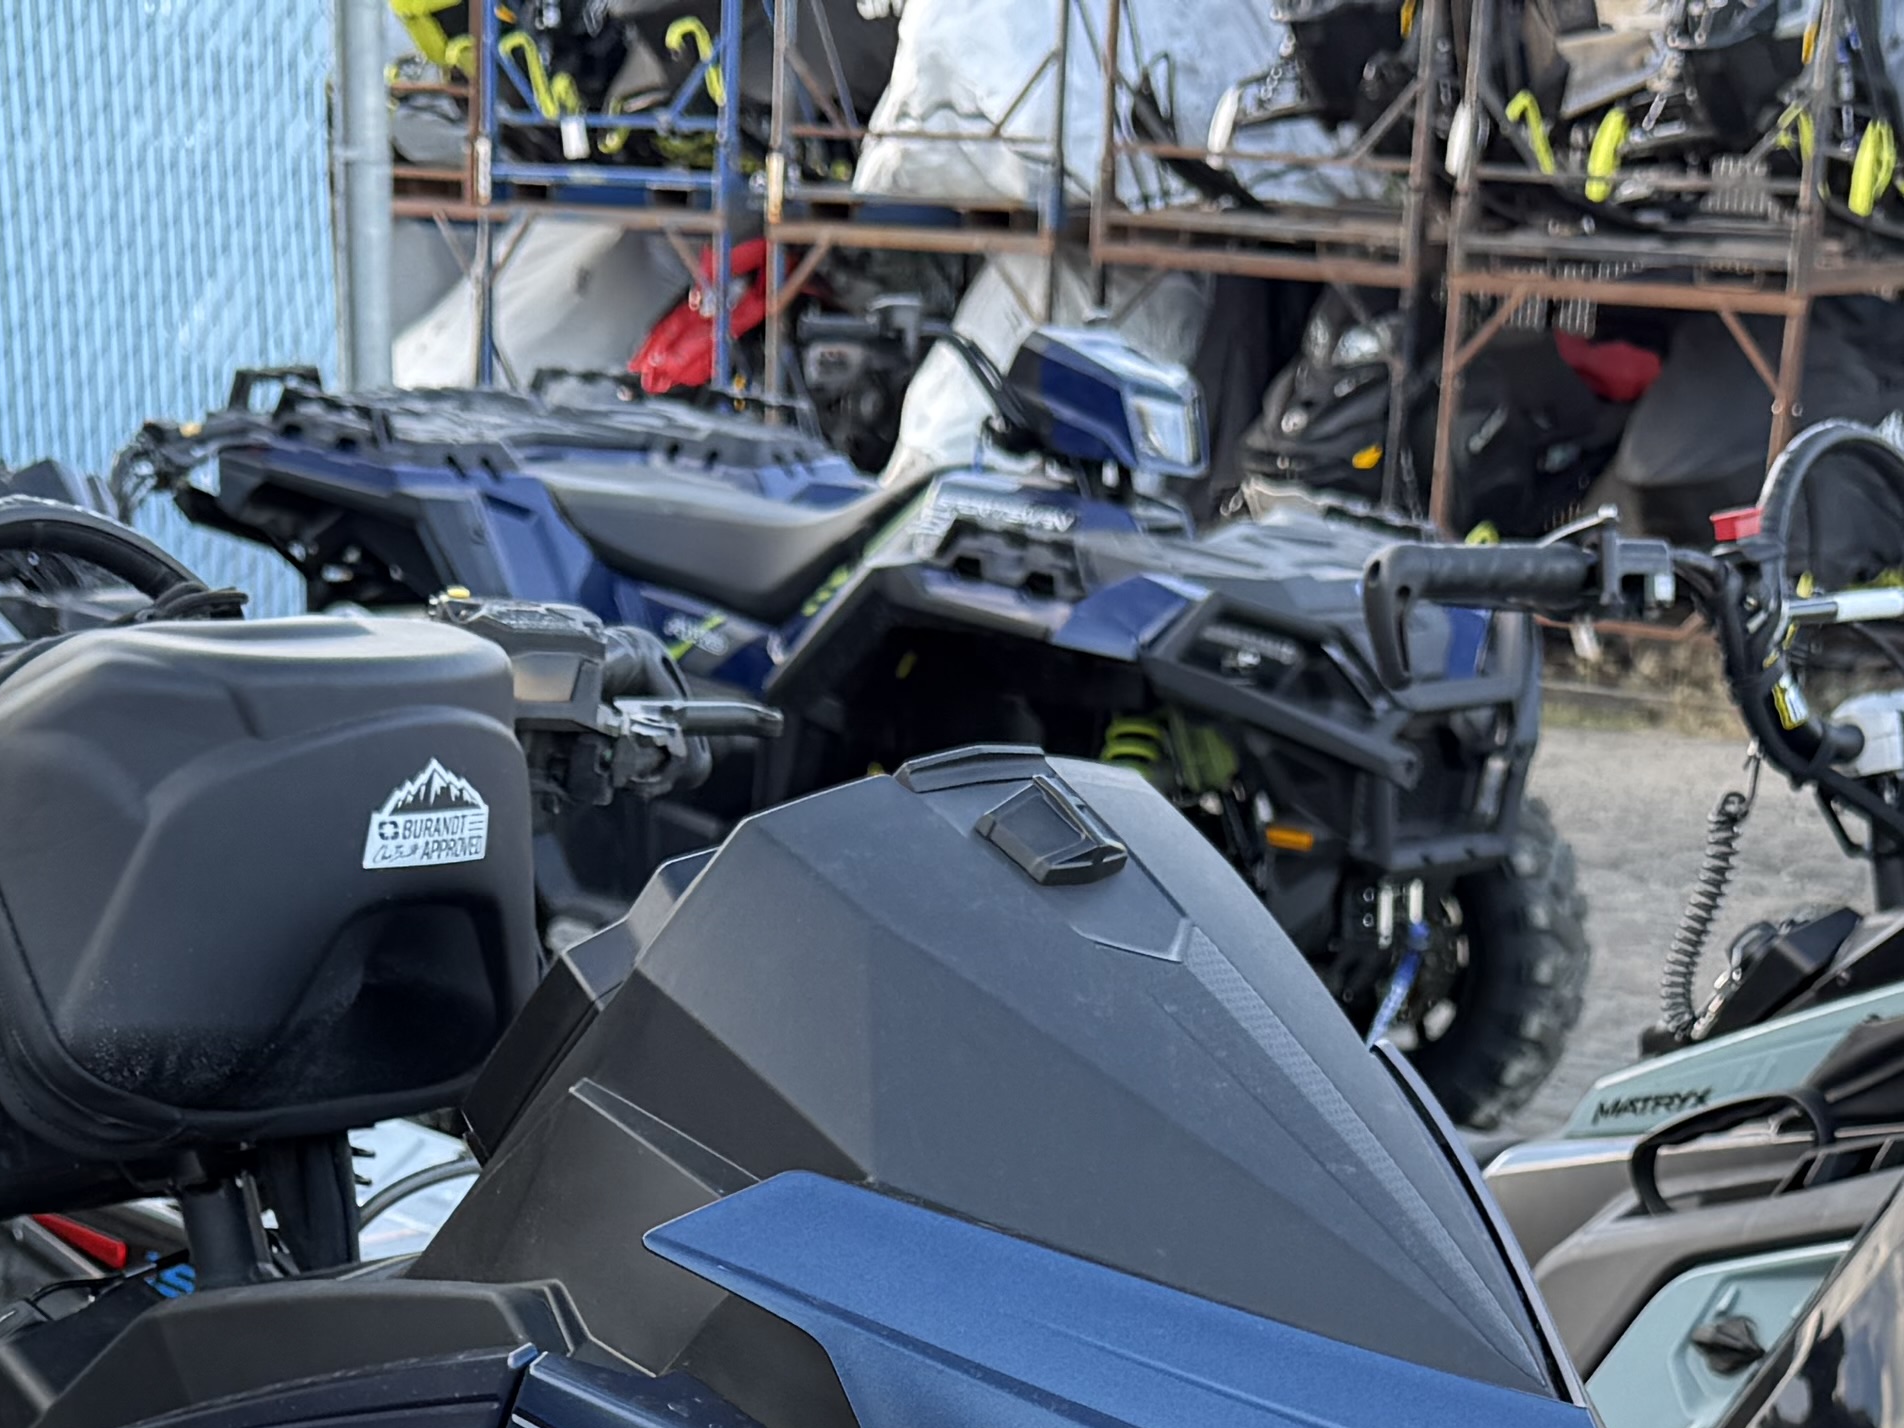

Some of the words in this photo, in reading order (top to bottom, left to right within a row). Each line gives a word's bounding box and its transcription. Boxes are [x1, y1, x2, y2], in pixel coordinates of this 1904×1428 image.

[401, 814, 467, 841] BURANDT
[419, 834, 483, 861] APPROVED
[1591, 1085, 1713, 1126] MATRYX
